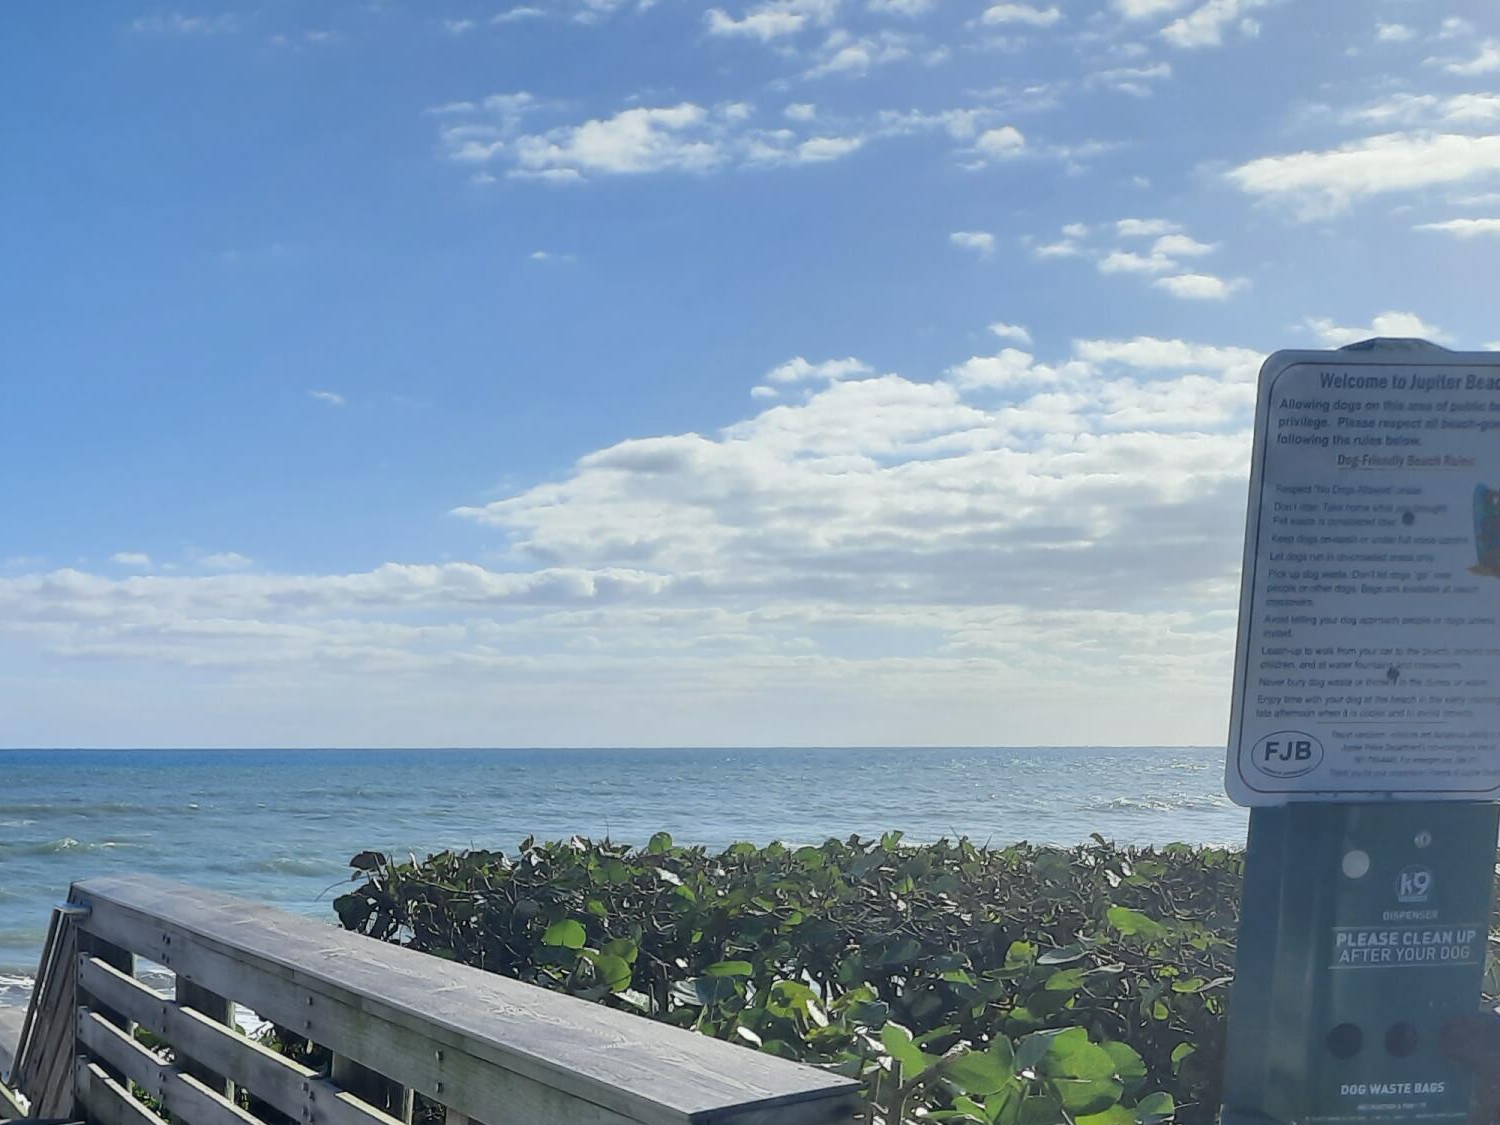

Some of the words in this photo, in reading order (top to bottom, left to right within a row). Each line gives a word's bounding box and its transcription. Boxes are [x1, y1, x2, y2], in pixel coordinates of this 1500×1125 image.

[1320, 372, 1388, 389] Welcome
[1392, 374, 1406, 390] to
[1410, 374, 1461, 393] Jupiter
[1280, 398, 1330, 413] Allowing
[1333, 400, 1361, 413] dogs
[1277, 433, 1329, 447] following
[1264, 741, 1312, 761] FJB
[1382, 910, 1439, 921] DISPENSER
[1336, 932, 1399, 947] PLEASE
[1402, 931, 1453, 945] CLEAN
[1457, 930, 1477, 944] UP
[1340, 948, 1391, 962] AFTER
[1396, 947, 1436, 961] YOUR
[1440, 946, 1470, 960] DOG
[1341, 1084, 1366, 1095] DOG
[1369, 1083, 1411, 1095] WASTE
[1414, 1082, 1445, 1093] BAGS
